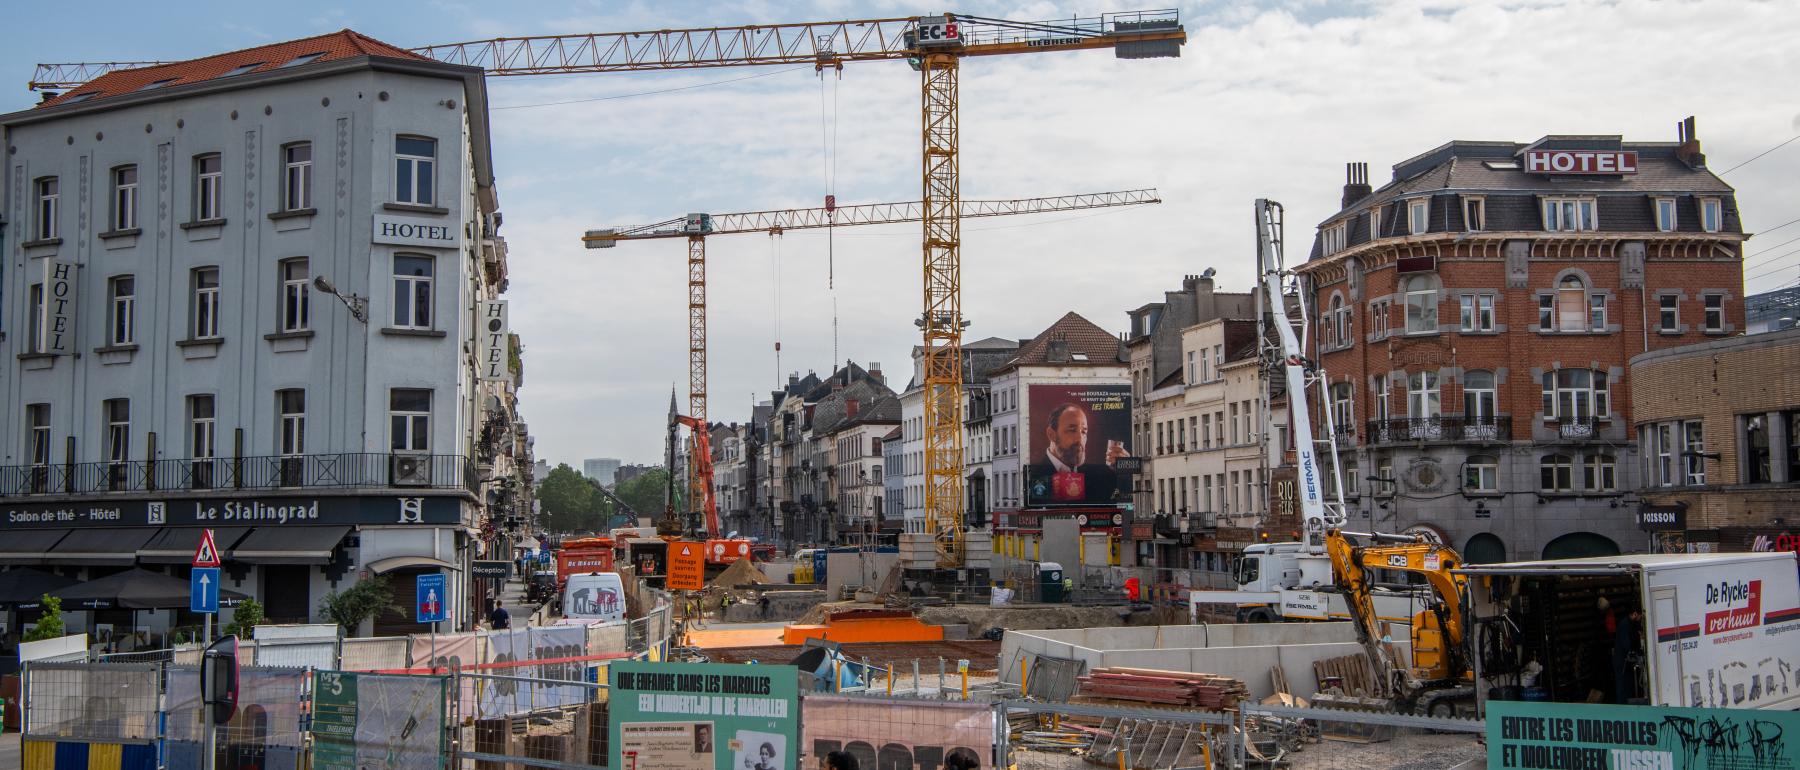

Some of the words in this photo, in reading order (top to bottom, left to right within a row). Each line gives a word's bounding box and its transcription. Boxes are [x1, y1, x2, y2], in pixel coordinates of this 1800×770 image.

[920, 24, 958, 40] EC-B
[1027, 38, 1082, 46] LIEBHERR
[1529, 152, 1636, 172] HOTEL
[381, 222, 454, 240] HOTEL
[53, 263, 70, 350] HOTEL
[487, 303, 504, 378] HOTEL
[1303, 451, 1317, 500] SERMAC
[1278, 480, 1294, 500] RIO
[9, 510, 40, 522] Salon
[41, 510, 54, 521] de
[57, 509, 74, 520] thé
[90, 508, 120, 520] Hôtel
[196, 502, 217, 520] Le
[224, 500, 319, 524] Stalingrad
[472, 566, 506, 575] Réception
[1387, 554, 1407, 566] JCB
[1706, 584, 1718, 605] De
[1721, 579, 1748, 607] Rycke
[1710, 609, 1756, 632] verhuur
[618, 672, 635, 690] UNE
[636, 673, 675, 692] ENFANCE
[677, 674, 702, 692] DANS
[705, 675, 721, 693] LES
[722, 676, 770, 695] MAROLLES
[724, 696, 736, 716] DE
[738, 697, 788, 718] MAROLLEN
[1502, 716, 1545, 740] ENTRE
[1549, 718, 1573, 742] LES
[1577, 719, 1657, 746] MAROLLES
[1503, 744, 1517, 768] ET
[1521, 745, 1609, 770] MOLENBEEK
[1611, 749, 1674, 770] TUSSEN
